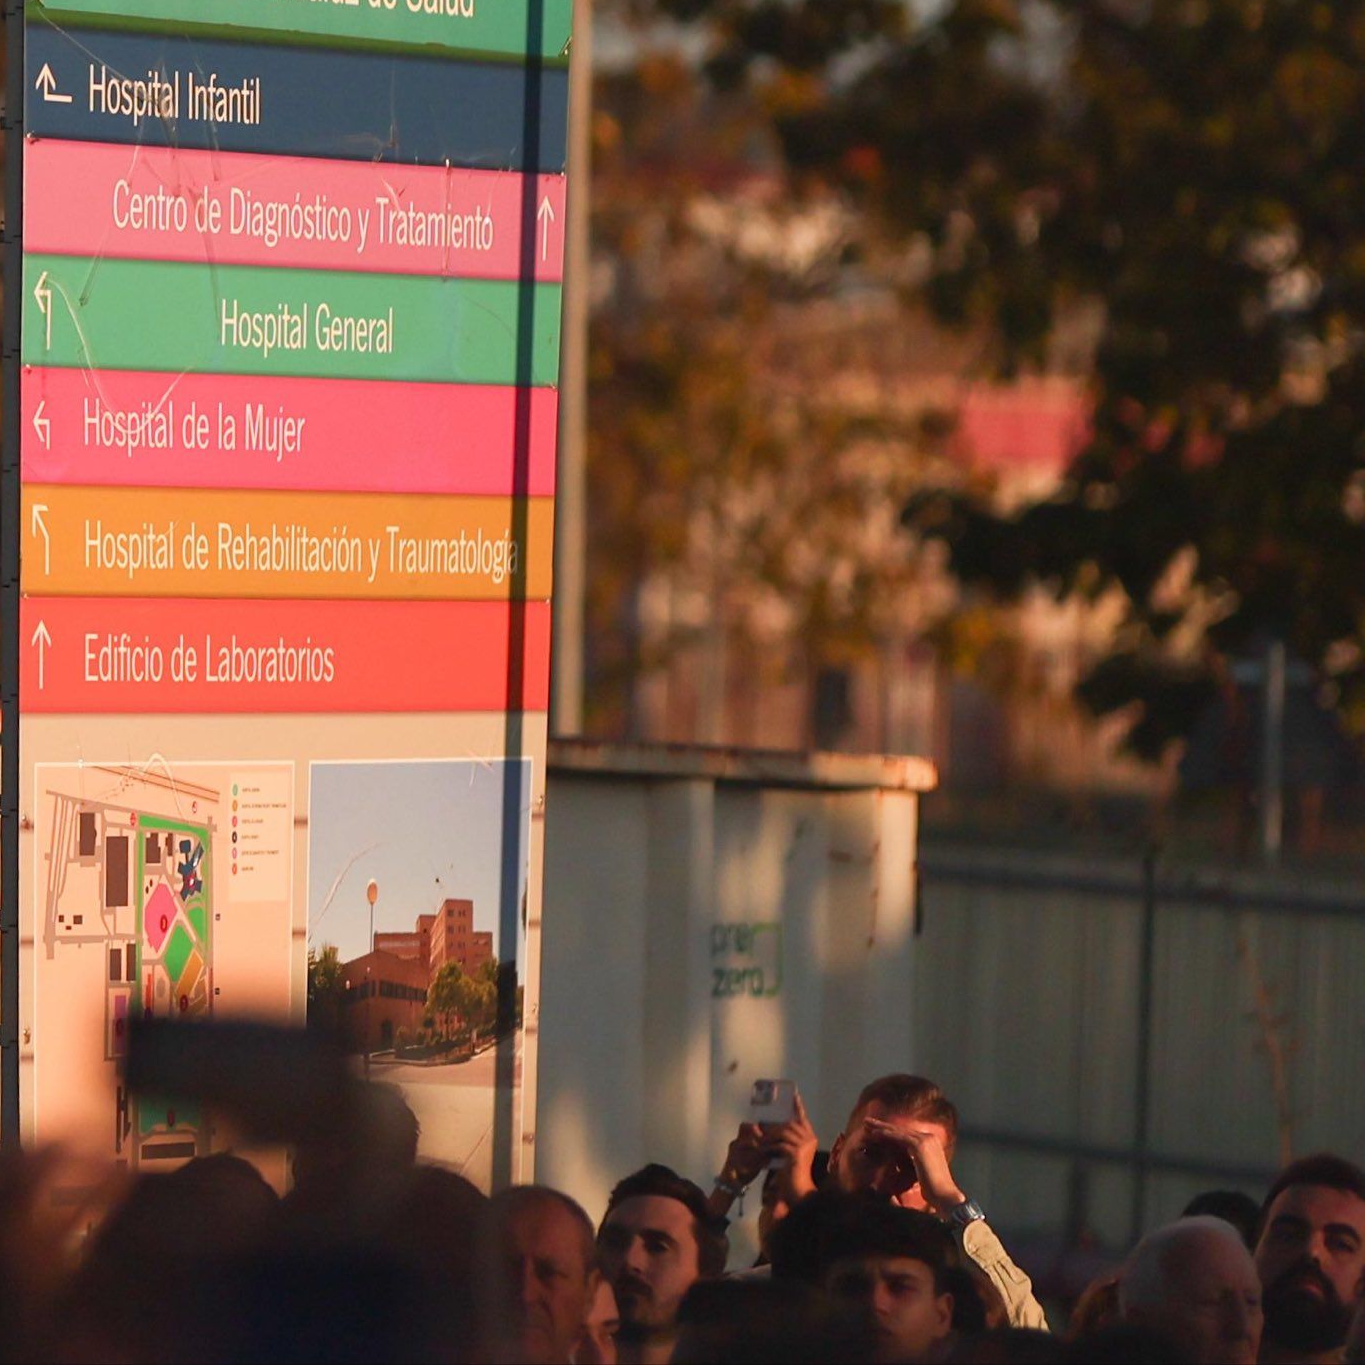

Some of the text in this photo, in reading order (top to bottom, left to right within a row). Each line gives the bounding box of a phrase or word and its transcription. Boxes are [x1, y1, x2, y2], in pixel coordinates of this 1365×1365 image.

[90, 64, 260, 126] Hospital Infantil
[114, 179, 493, 253] Centro de Diagnóstico y Tratamiento
[222, 299, 392, 358] Hospital General
[84, 397, 305, 462] Hospital de la Mujer
[86, 520, 518, 583] Hospital de Rehabilitación y Traumatología
[85, 634, 334, 682] Edificio de Laboratorios
